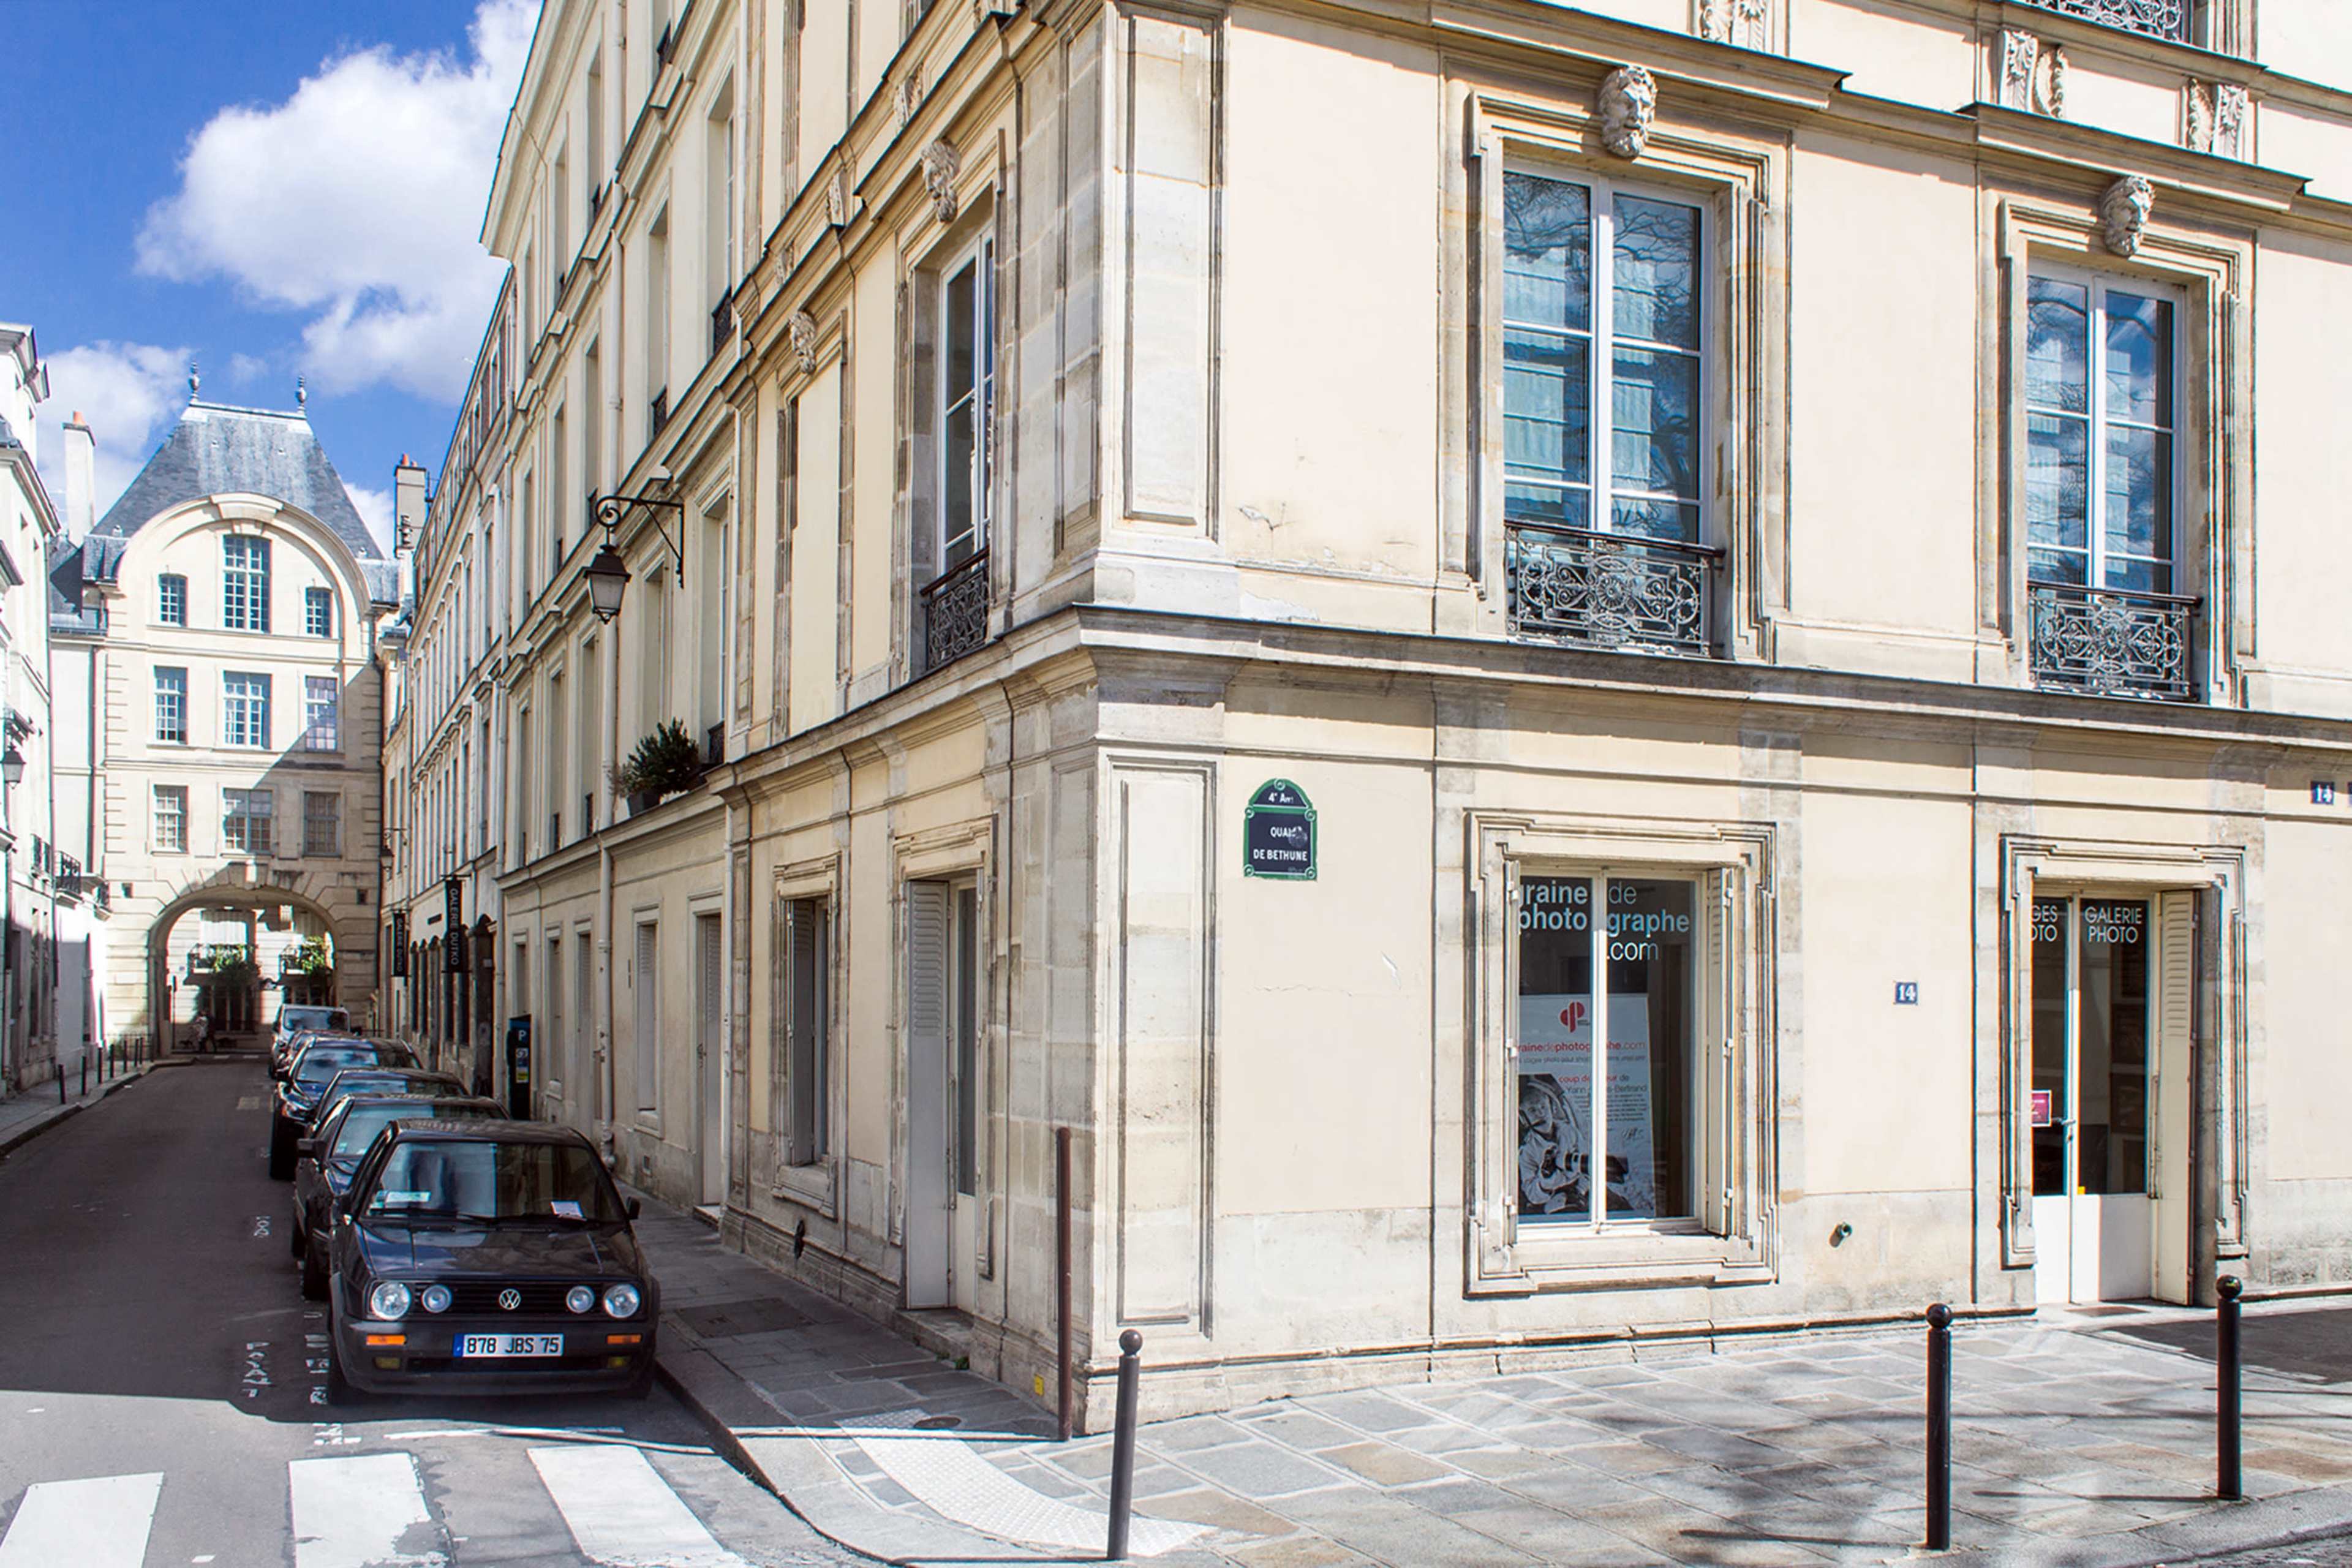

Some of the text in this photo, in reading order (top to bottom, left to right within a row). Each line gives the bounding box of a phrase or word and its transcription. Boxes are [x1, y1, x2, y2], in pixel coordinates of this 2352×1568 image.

[1253, 848, 1308, 861] DE BETHUNE
[1608, 881, 1637, 905] de
[1606, 908, 1690, 938] graphe
[2084, 906, 2143, 924] GALERIE
[450, 888, 459, 965] GALERIE DUTKO
[2087, 925, 2139, 944] PHOTO
[1606, 941, 1659, 961] .com
[1898, 984, 1916, 1001] 14
[518, 1029, 527, 1041] P
[467, 1336, 560, 1354] 878 JBS 75
